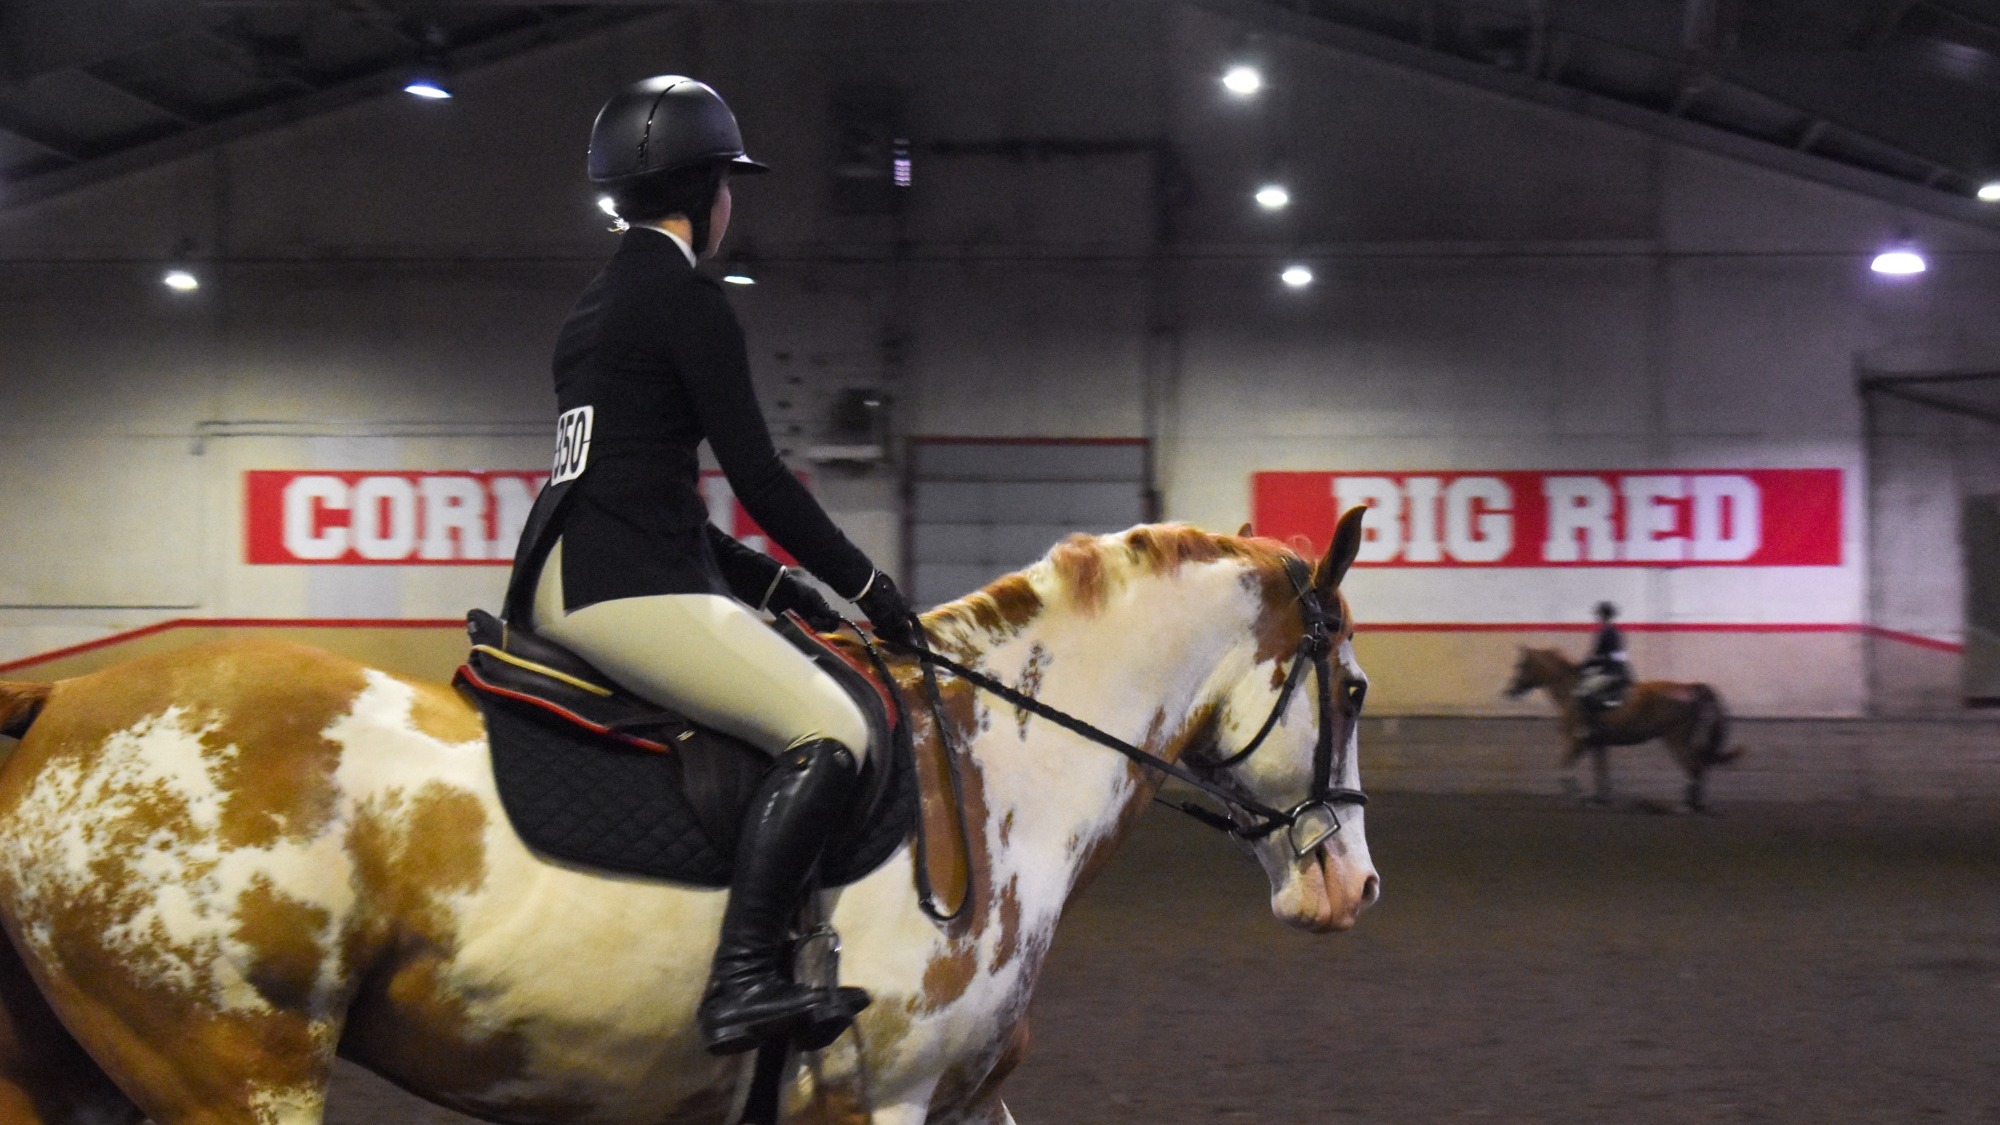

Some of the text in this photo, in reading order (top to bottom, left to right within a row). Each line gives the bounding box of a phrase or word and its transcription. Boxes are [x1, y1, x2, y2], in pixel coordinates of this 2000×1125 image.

[282, 476, 766, 560] CORN
[1332, 475, 1761, 562] BIG RED
